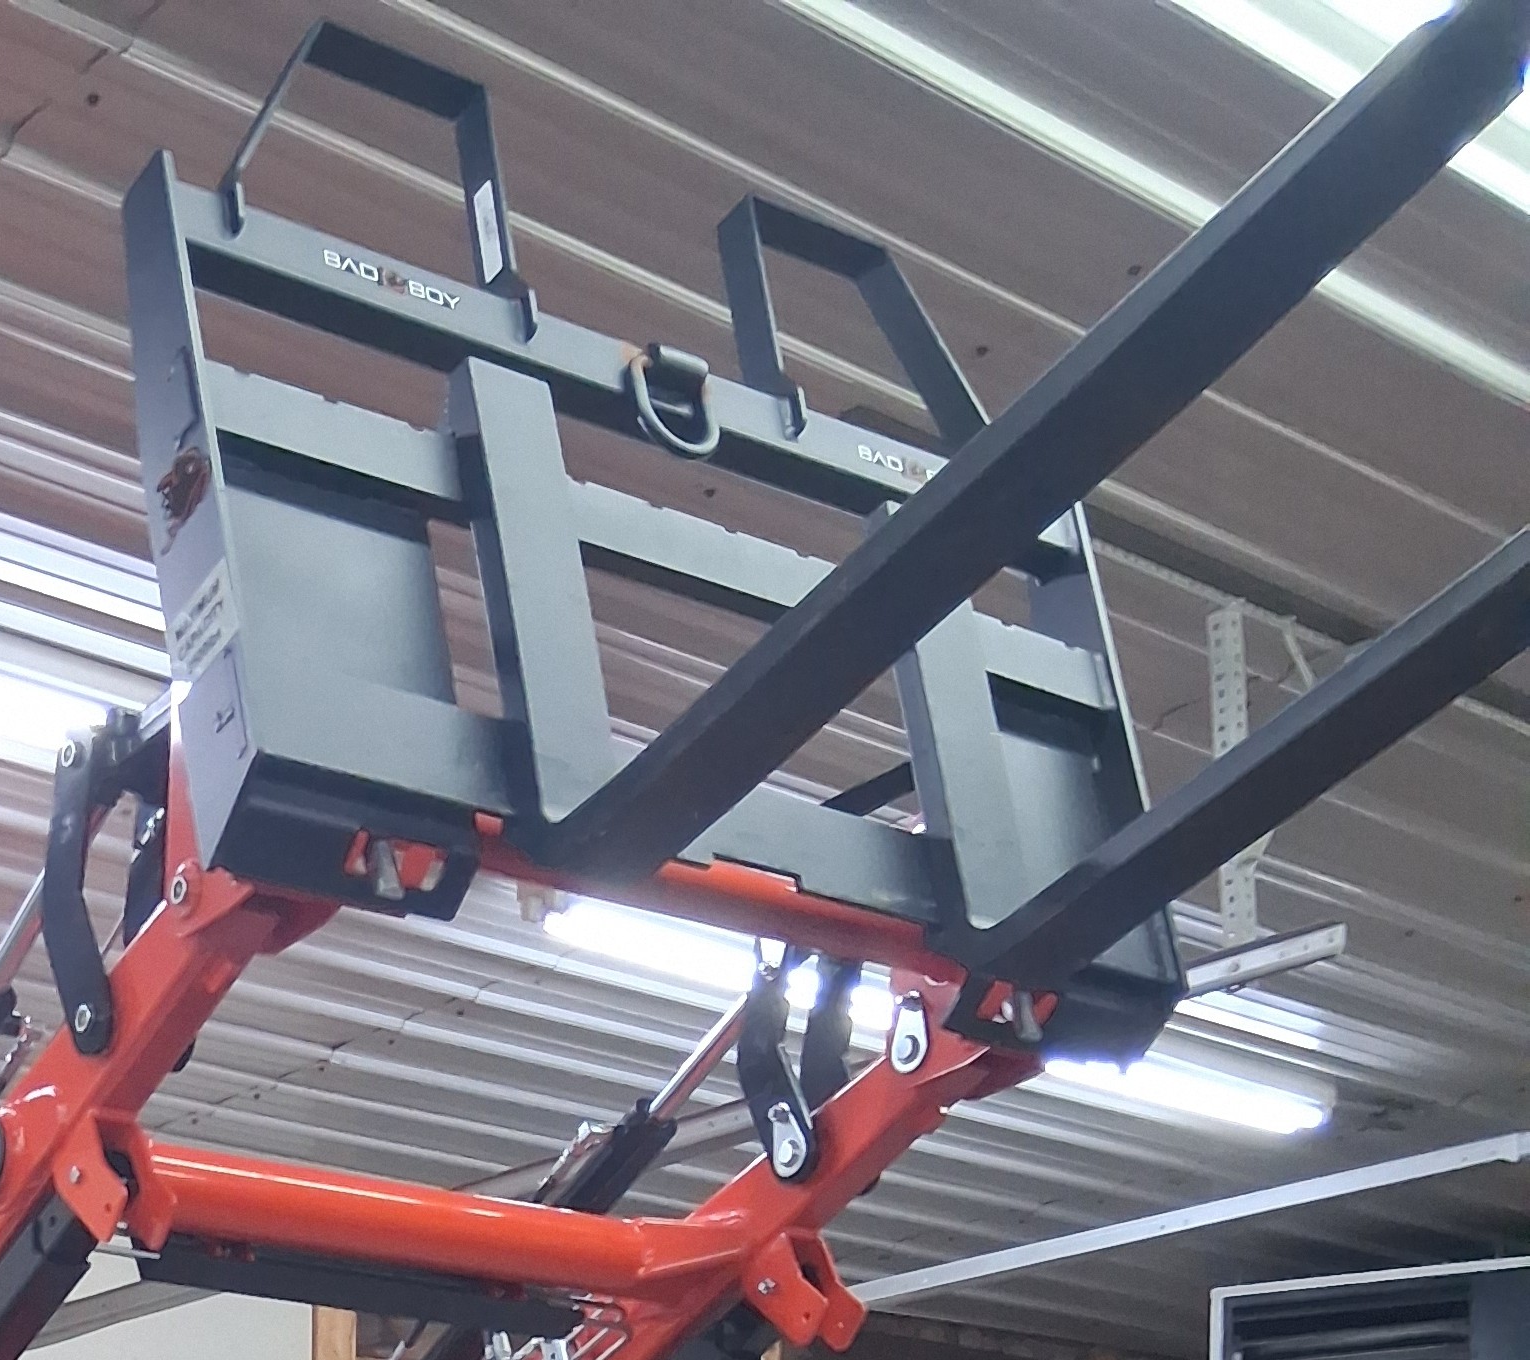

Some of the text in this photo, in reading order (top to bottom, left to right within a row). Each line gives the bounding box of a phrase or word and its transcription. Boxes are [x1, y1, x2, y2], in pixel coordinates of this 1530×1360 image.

[323, 249, 461, 310] BAD BOY
[857, 444, 904, 472] BAD
